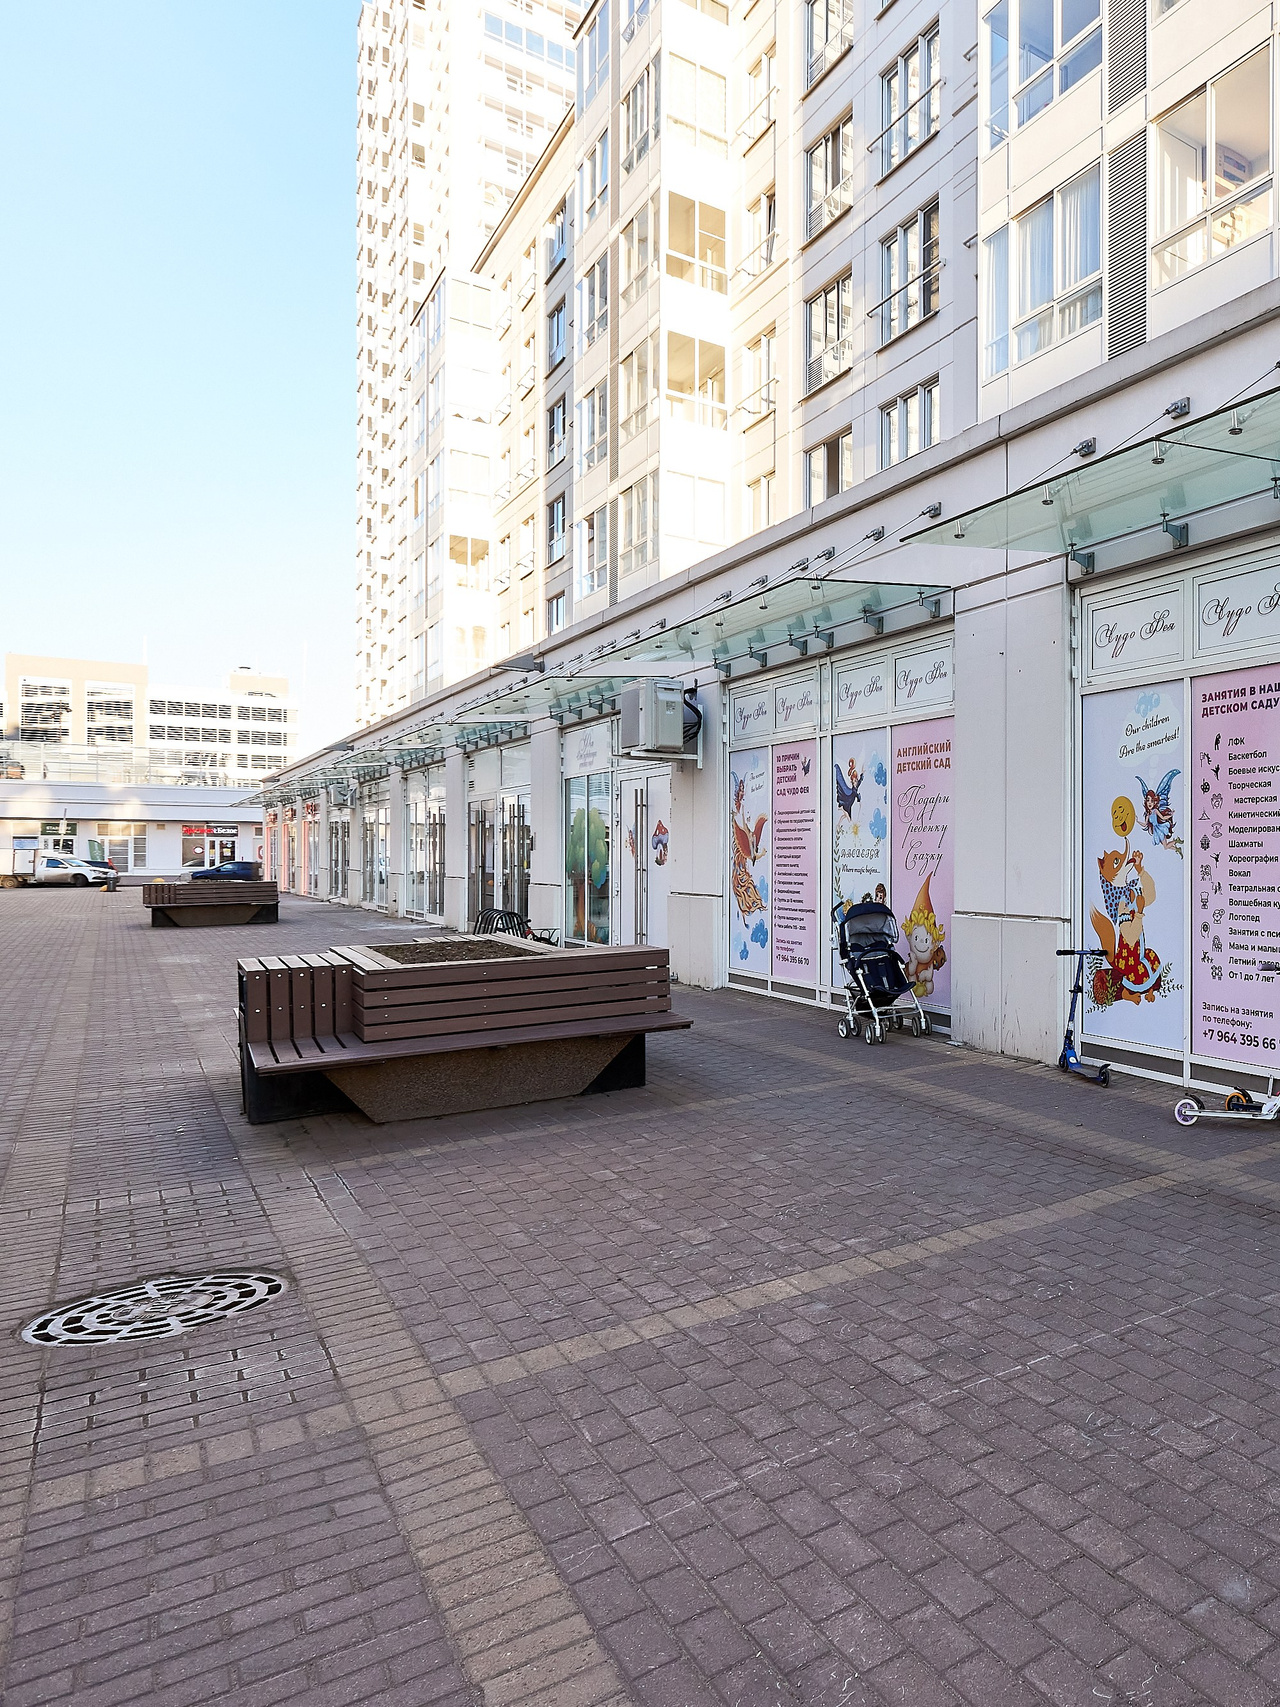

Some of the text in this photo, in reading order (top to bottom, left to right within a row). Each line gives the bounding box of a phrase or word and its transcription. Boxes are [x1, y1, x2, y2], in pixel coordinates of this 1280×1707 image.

[1202, 597, 1252, 636] Чудо
[1095, 609, 1175, 658] Чудо Фея
[1201, 687, 1246, 702] ЗАНЯТИЯ
[1249, 686, 1256, 696] В
[1201, 697, 1280, 718] ДЕТСКОМ САДУ
[1125, 714, 1170, 736] Our children
[1119, 726, 1180, 758] Are the smartest!
[1227, 737, 1245, 746] ЛФК
[896, 739, 951, 758] АНГЛИЙСКИЙ
[1228, 750, 1267, 761] Баскетбол
[776, 764, 798, 773] ВЫБРАТЬ
[896, 757, 951, 774] ДЕТСКИЙ САД
[1228, 767, 1257, 775] Боевые
[786, 787, 799, 796] ЧУДО
[799, 786, 810, 794] ФЕЯ
[1228, 781, 1272, 791] Творческая
[897, 784, 950, 823] Подари
[1234, 795, 1278, 805] мастерская
[901, 818, 948, 849] ребенку
[1228, 840, 1264, 848] Шахматы
[905, 839, 943, 876] Сказку
[1228, 854, 1279, 864] Хореография
[1228, 869, 1251, 877] Вокал
[1228, 884, 1276, 893] Театральная
[1228, 898, 1272, 907] Волшебная
[1228, 912, 1261, 923] Логопед
[1228, 927, 1259, 937] Занятия
[1228, 942, 1250, 951] Мама
[1228, 956, 1256, 966] Летний
[1228, 971, 1238, 979] От
[1244, 973, 1254, 981] до
[1255, 973, 1260, 981] 7
[1261, 975, 1275, 983] лет
[1202, 1001, 1229, 1013] Запись
[1241, 1008, 1274, 1019] занятия
[1213, 1016, 1252, 1029] телефону:
[1202, 1028, 1215, 1040] +7
[1216, 1030, 1237, 1044] 964
[1239, 1033, 1260, 1047] 395
[1262, 1037, 1276, 1050] 66
